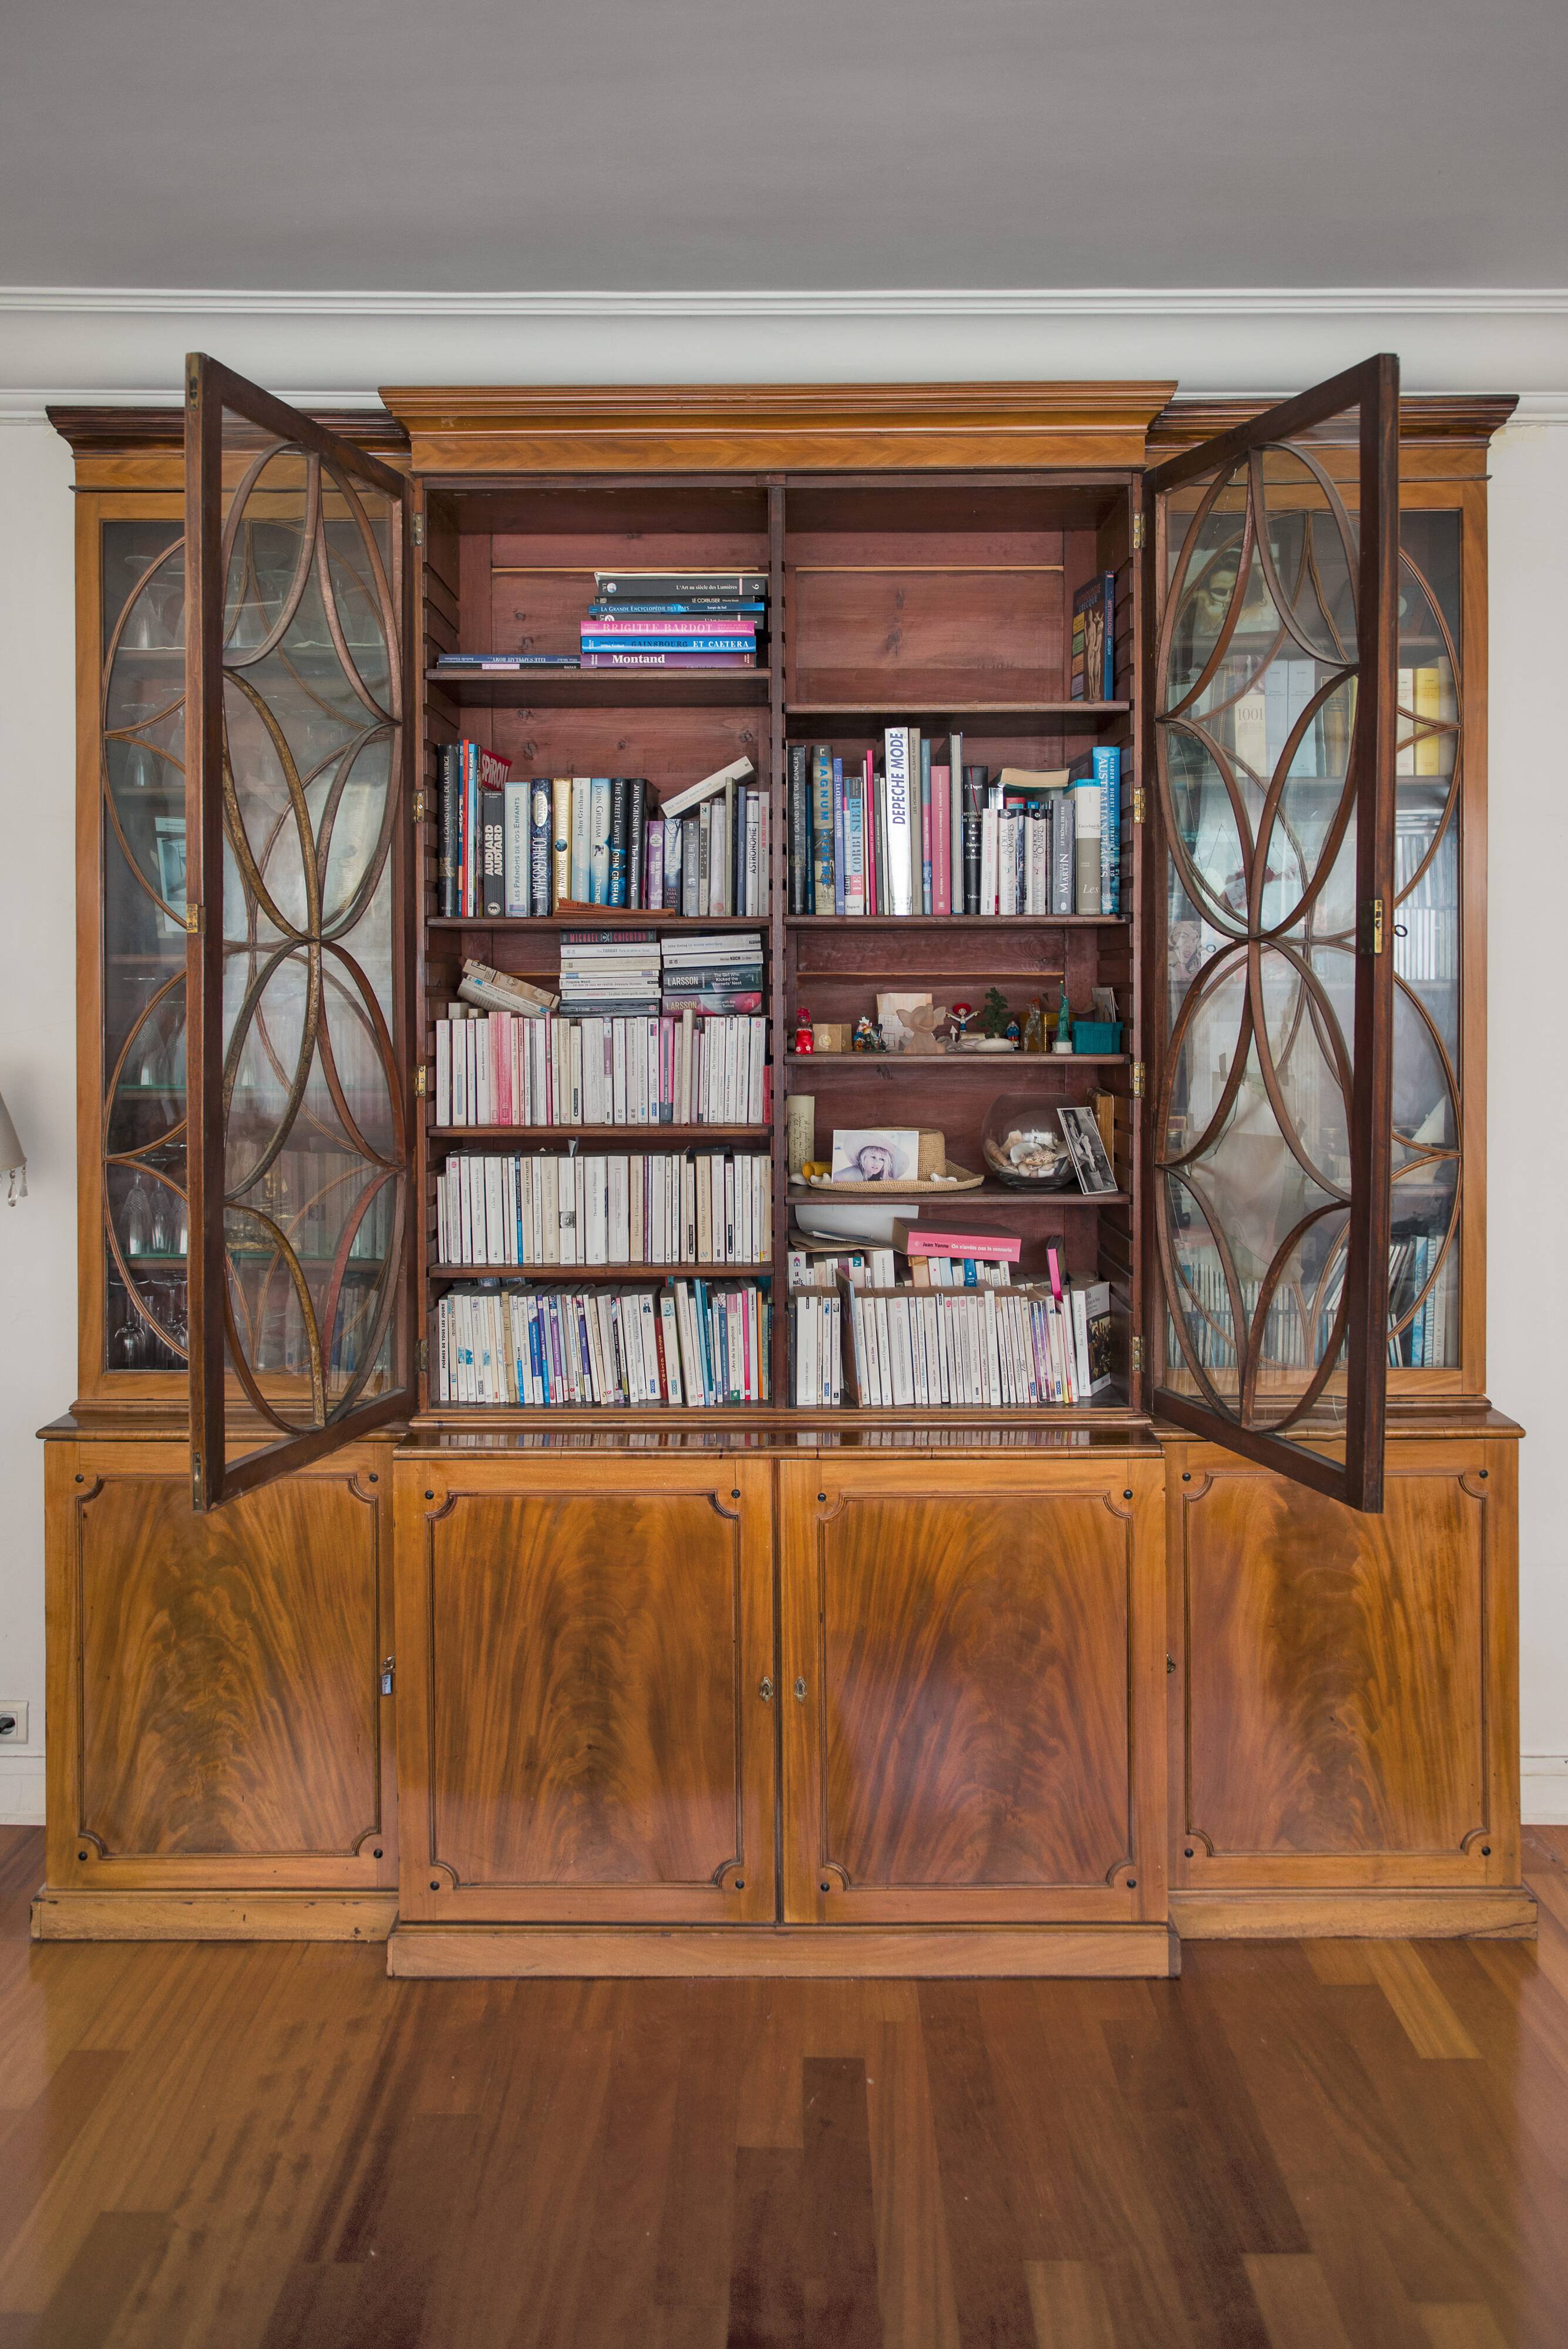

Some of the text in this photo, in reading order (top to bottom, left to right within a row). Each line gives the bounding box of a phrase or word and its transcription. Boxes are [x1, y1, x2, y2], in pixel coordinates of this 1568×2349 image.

[603, 624, 659, 632] BRIGITTE
[664, 624, 712, 632] BARDOT
[612, 655, 665, 664] Montand
[793, 782, 799, 790] DU
[819, 757, 829, 820] MAGNUM
[890, 733, 906, 825] DEPECHE MODE
[1099, 756, 1108, 832] AUSTRALIAN
[613, 820, 622, 844] LAWYER
[485, 824, 494, 876] AUDIARD
[494, 824, 503, 876] AUDIARD
[514, 844, 520, 854] DE
[533, 837, 546, 859] JOHN
[748, 828, 756, 874] ASTRONOMIE
[850, 800, 862, 891] LE CORBUSIER
[613, 849, 621, 869] JOHN
[688, 853, 696, 876] TESTAMENT
[533, 861, 546, 898] GRISHAM
[1059, 854, 1069, 893] MARTIN
[1084, 884, 1099, 893] Les
[570, 933, 647, 943] MICHAEL CRICHTON
[668, 977, 698, 985] LARSSON
[667, 1001, 697, 1009] LARSSON
